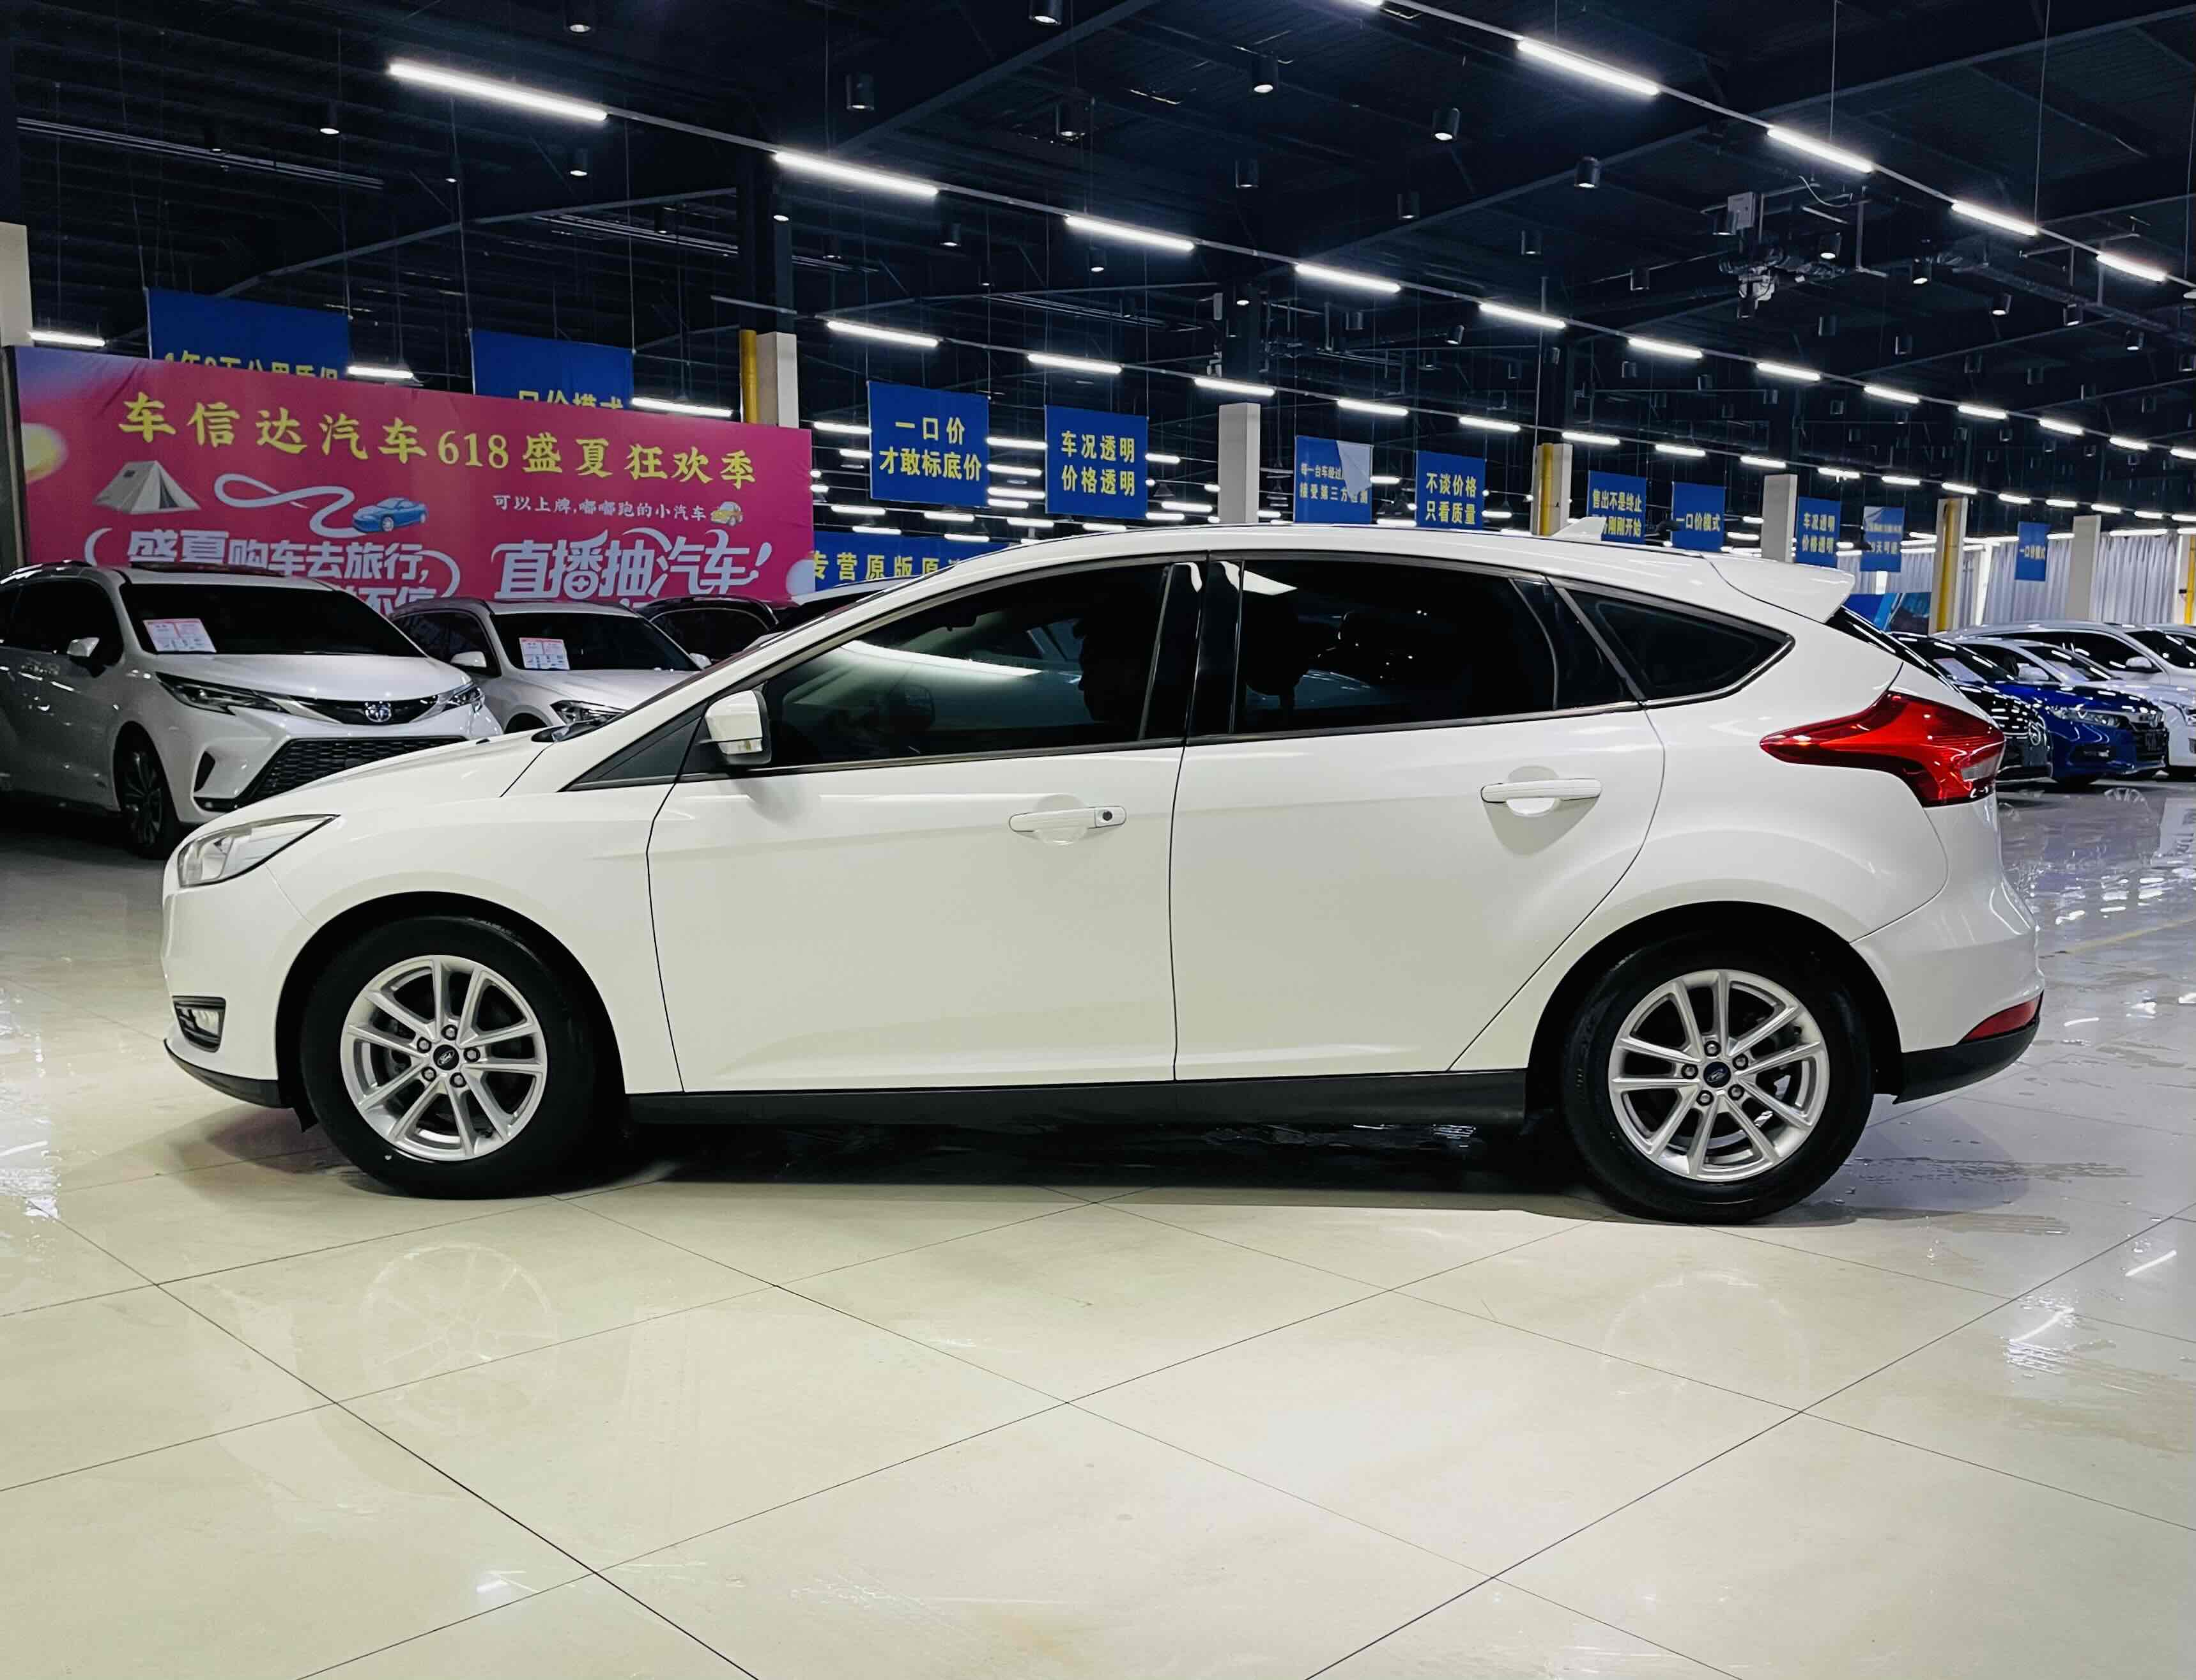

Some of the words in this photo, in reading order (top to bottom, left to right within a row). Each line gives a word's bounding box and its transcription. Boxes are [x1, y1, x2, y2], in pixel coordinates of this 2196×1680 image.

[118, 392, 756, 490] 车信达汽车618盛夏狂欢季
[895, 417, 965, 445] 一口价
[1061, 431, 1135, 464] 车况透明
[879, 449, 981, 481] 才敢标底价
[1061, 465, 1135, 496] 价格透明
[1426, 473, 1476, 498] 不谈价格
[1425, 500, 1476, 525] 只看质量
[1592, 514, 1641, 537] 刚刚开始
[813, 551, 958, 581] 专营原版原
